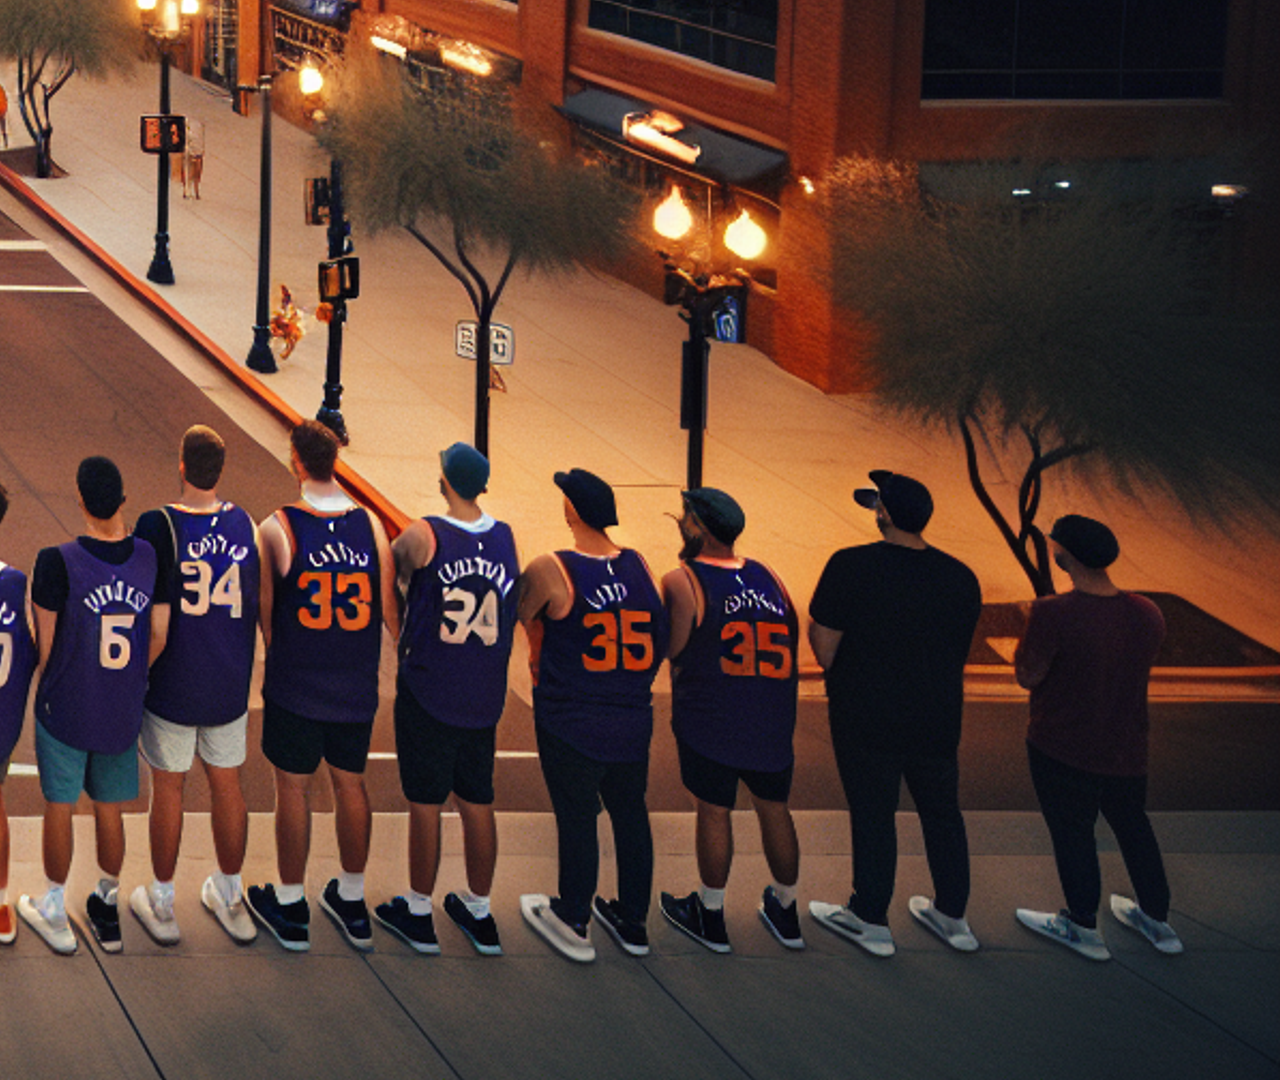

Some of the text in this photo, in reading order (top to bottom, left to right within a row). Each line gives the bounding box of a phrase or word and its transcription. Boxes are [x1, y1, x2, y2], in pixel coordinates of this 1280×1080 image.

[180, 560, 244, 618] 34
[297, 571, 372, 631] 33
[439, 586, 499, 646] 34
[100, 614, 135, 670] 6
[582, 609, 654, 672] 35
[720, 621, 792, 680] 35
